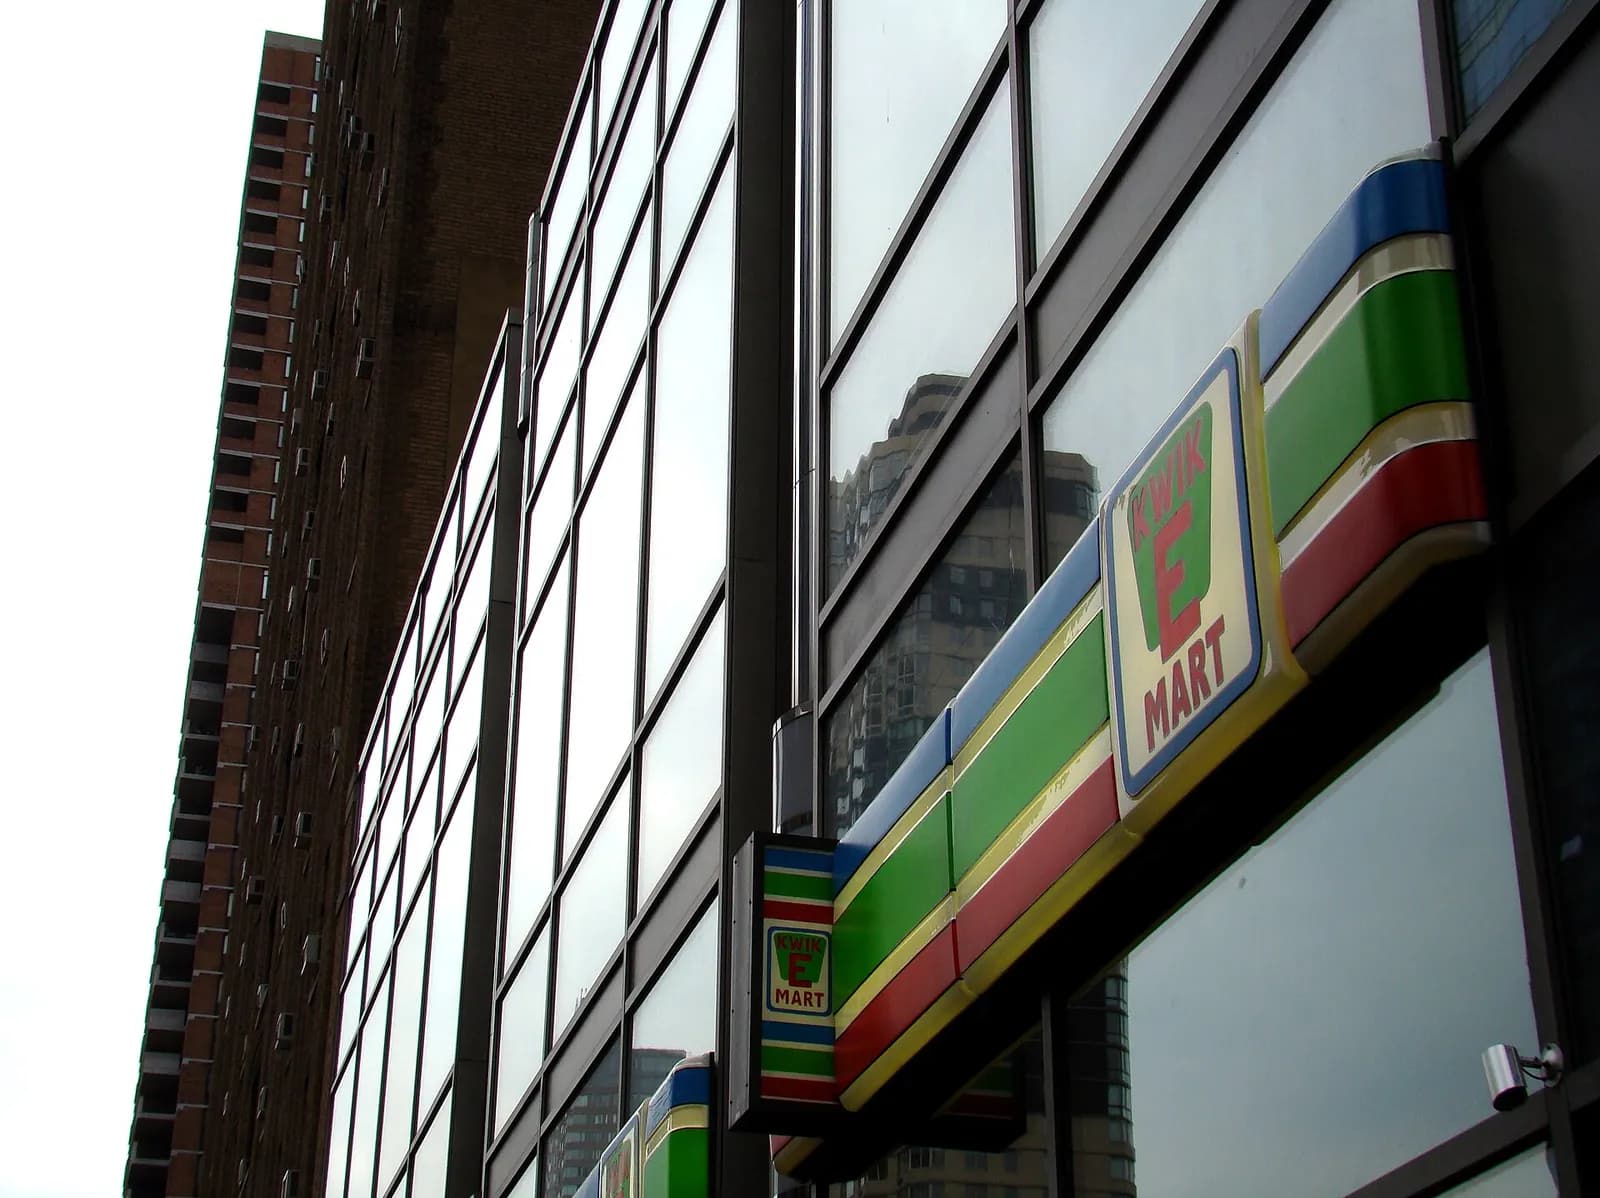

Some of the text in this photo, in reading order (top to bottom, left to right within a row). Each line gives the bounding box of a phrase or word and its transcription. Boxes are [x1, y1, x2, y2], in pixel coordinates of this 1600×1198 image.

[1131, 416, 1206, 552] KWIK
[1153, 500, 1202, 665] E
[1143, 613, 1225, 754] MART
[776, 935, 821, 953] KWIK
[788, 952, 813, 988] E
[775, 988, 825, 1008] MART
